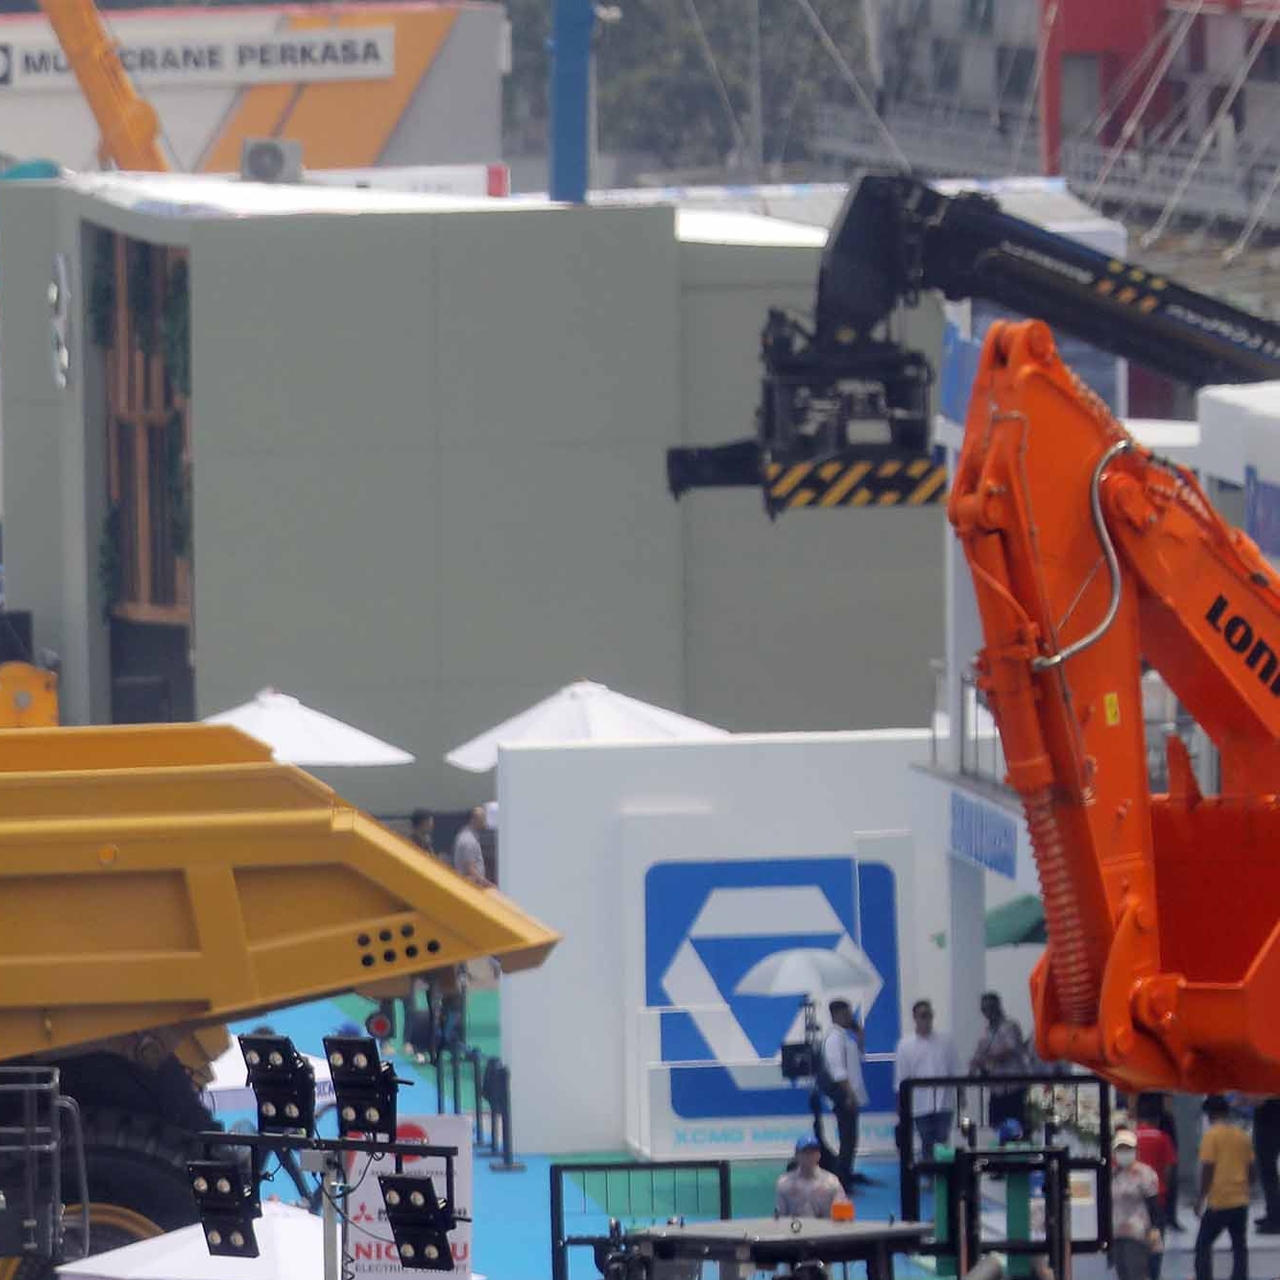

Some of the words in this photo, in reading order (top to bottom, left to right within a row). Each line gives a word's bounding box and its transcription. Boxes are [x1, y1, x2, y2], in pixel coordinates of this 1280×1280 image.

[24, 43, 222, 75] MUCRANE
[240, 40, 381, 67] PERKASA
[355, 1243, 468, 1261] NICU
